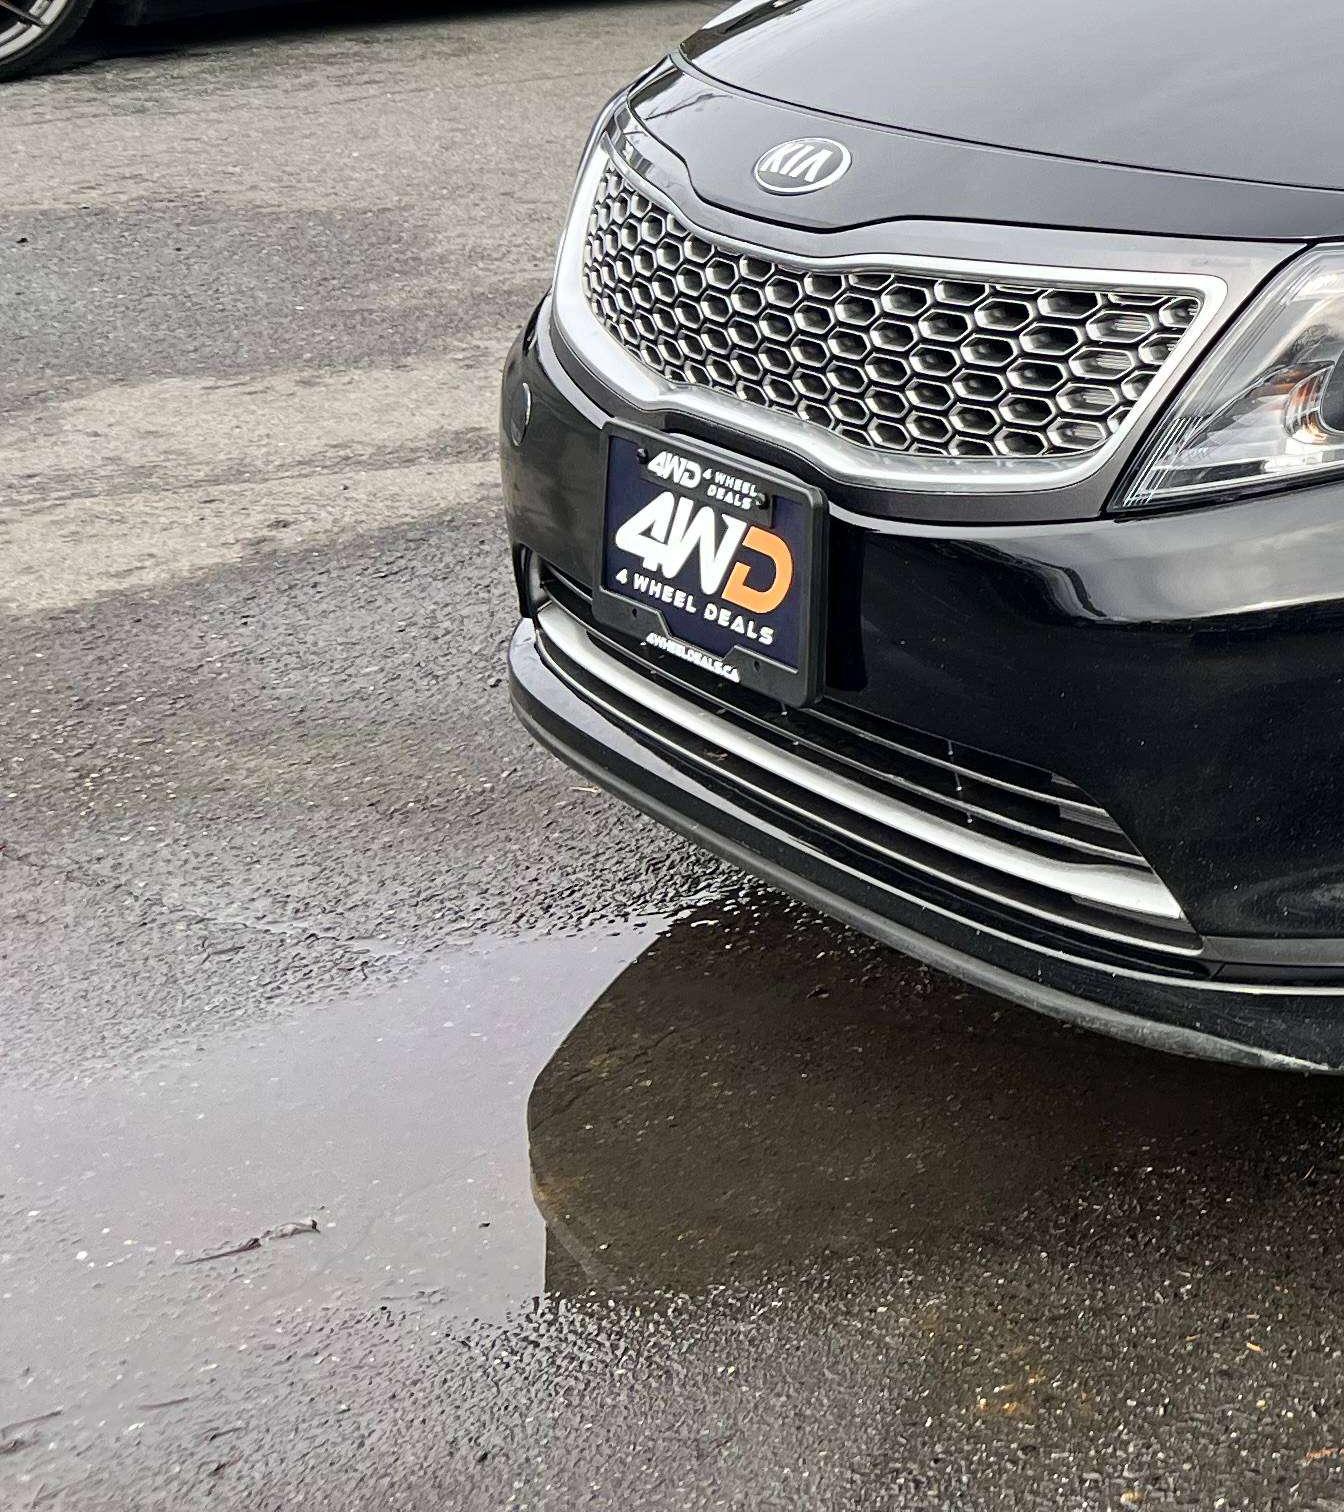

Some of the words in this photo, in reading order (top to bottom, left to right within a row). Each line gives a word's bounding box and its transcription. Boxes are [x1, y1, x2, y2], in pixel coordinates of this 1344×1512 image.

[758, 142, 834, 183] KIA
[647, 450, 702, 490] 4WD
[702, 467, 713, 482] 4
[714, 471, 760, 498] WHEEL
[706, 484, 753, 510] DEALS
[615, 490, 794, 614] 4WD
[615, 568, 628, 585] 4
[633, 572, 697, 614] WHEEL
[703, 602, 775, 646] DEALS
